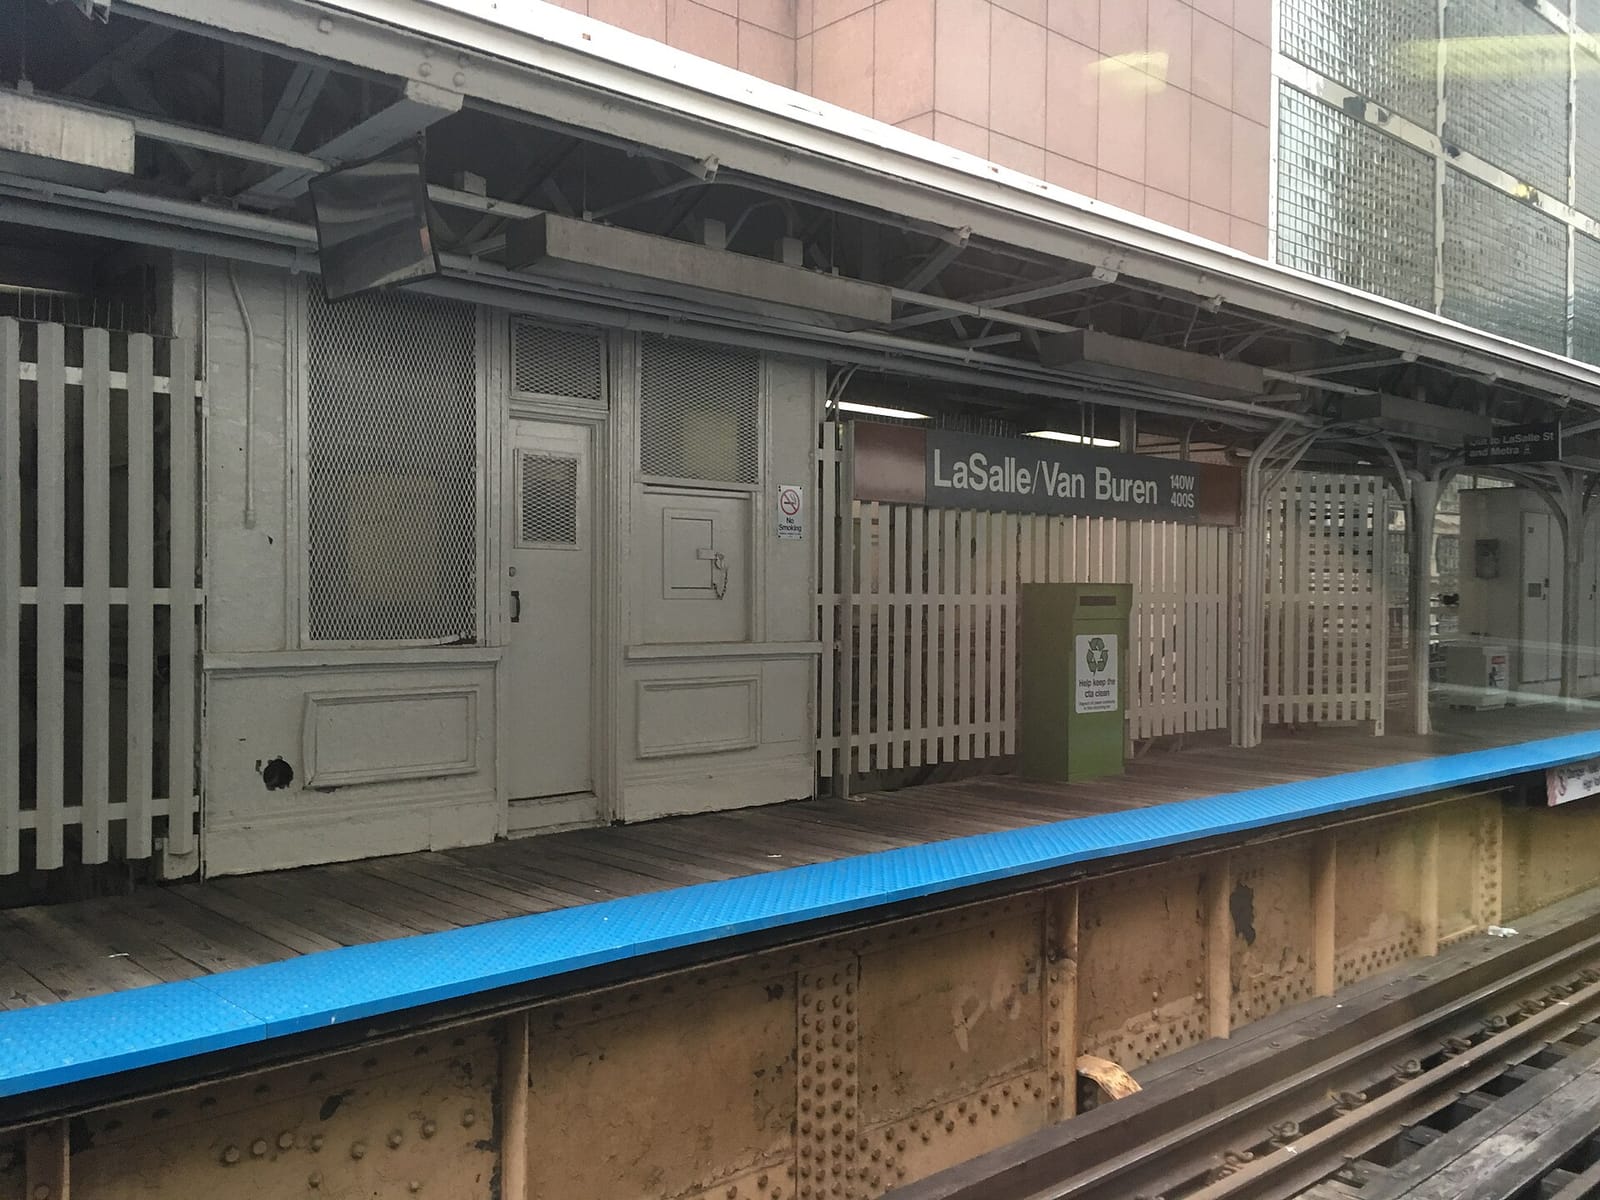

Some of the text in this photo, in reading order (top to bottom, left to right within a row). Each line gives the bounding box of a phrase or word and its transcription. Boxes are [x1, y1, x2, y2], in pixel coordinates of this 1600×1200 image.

[1502, 434, 1540, 444] LaSalle
[1543, 432, 1554, 440] St
[1470, 447, 1520, 457] and Metra
[1095, 465, 1158, 505] Buren
[1169, 474, 1195, 491] 140W
[1170, 491, 1195, 509] 400S
[779, 524, 802, 533] Smoking
[1079, 680, 1091, 688] Help
[1093, 679, 1106, 687] keep
